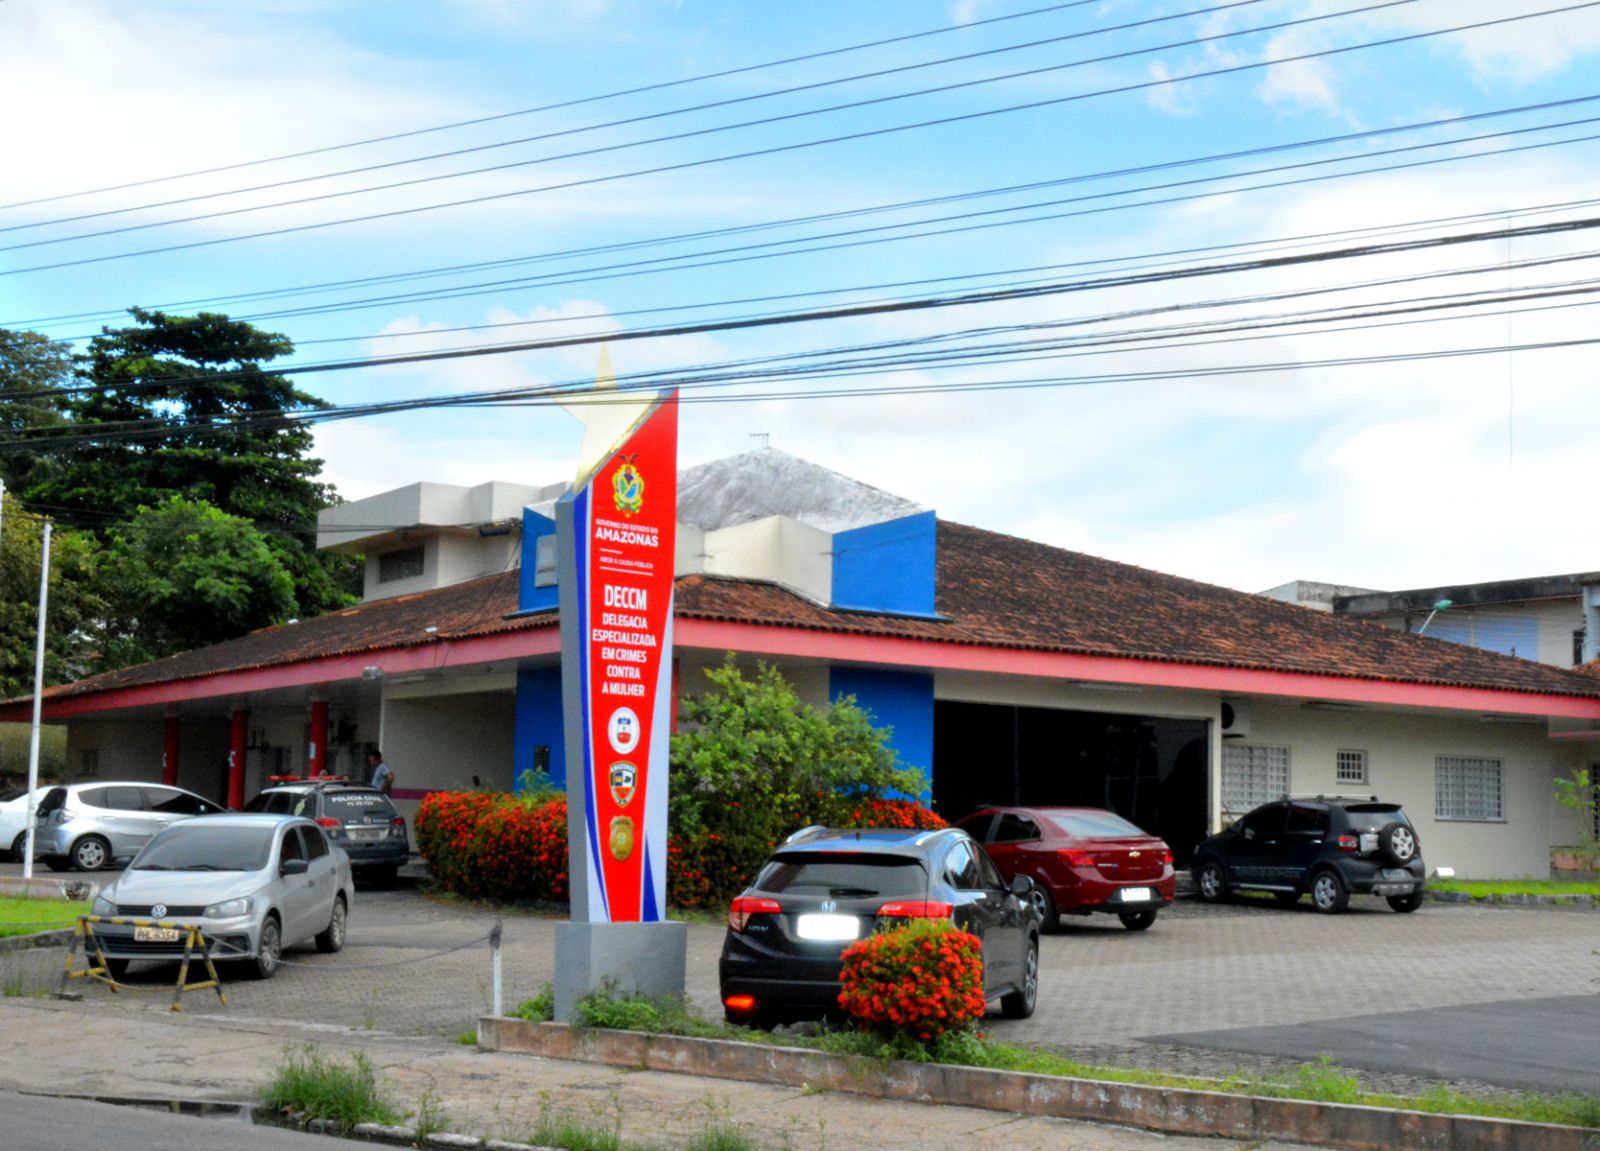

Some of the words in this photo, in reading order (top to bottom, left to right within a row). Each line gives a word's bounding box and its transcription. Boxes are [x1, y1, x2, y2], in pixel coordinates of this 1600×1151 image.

[595, 518, 621, 529] GOVERNO
[622, 522, 630, 530] DO
[630, 523, 649, 533] ESTADO
[595, 526, 659, 548] AMAZONAS
[604, 584, 647, 611] DECCM
[602, 612, 649, 629] DELEGACIA
[592, 628, 657, 647] ESPECIALIZADA
[602, 647, 615, 660] EM
[616, 648, 648, 663] CRIMES
[607, 665, 641, 679] CONTRA
[602, 681, 609, 694] A
[610, 682, 645, 697] MULHER
